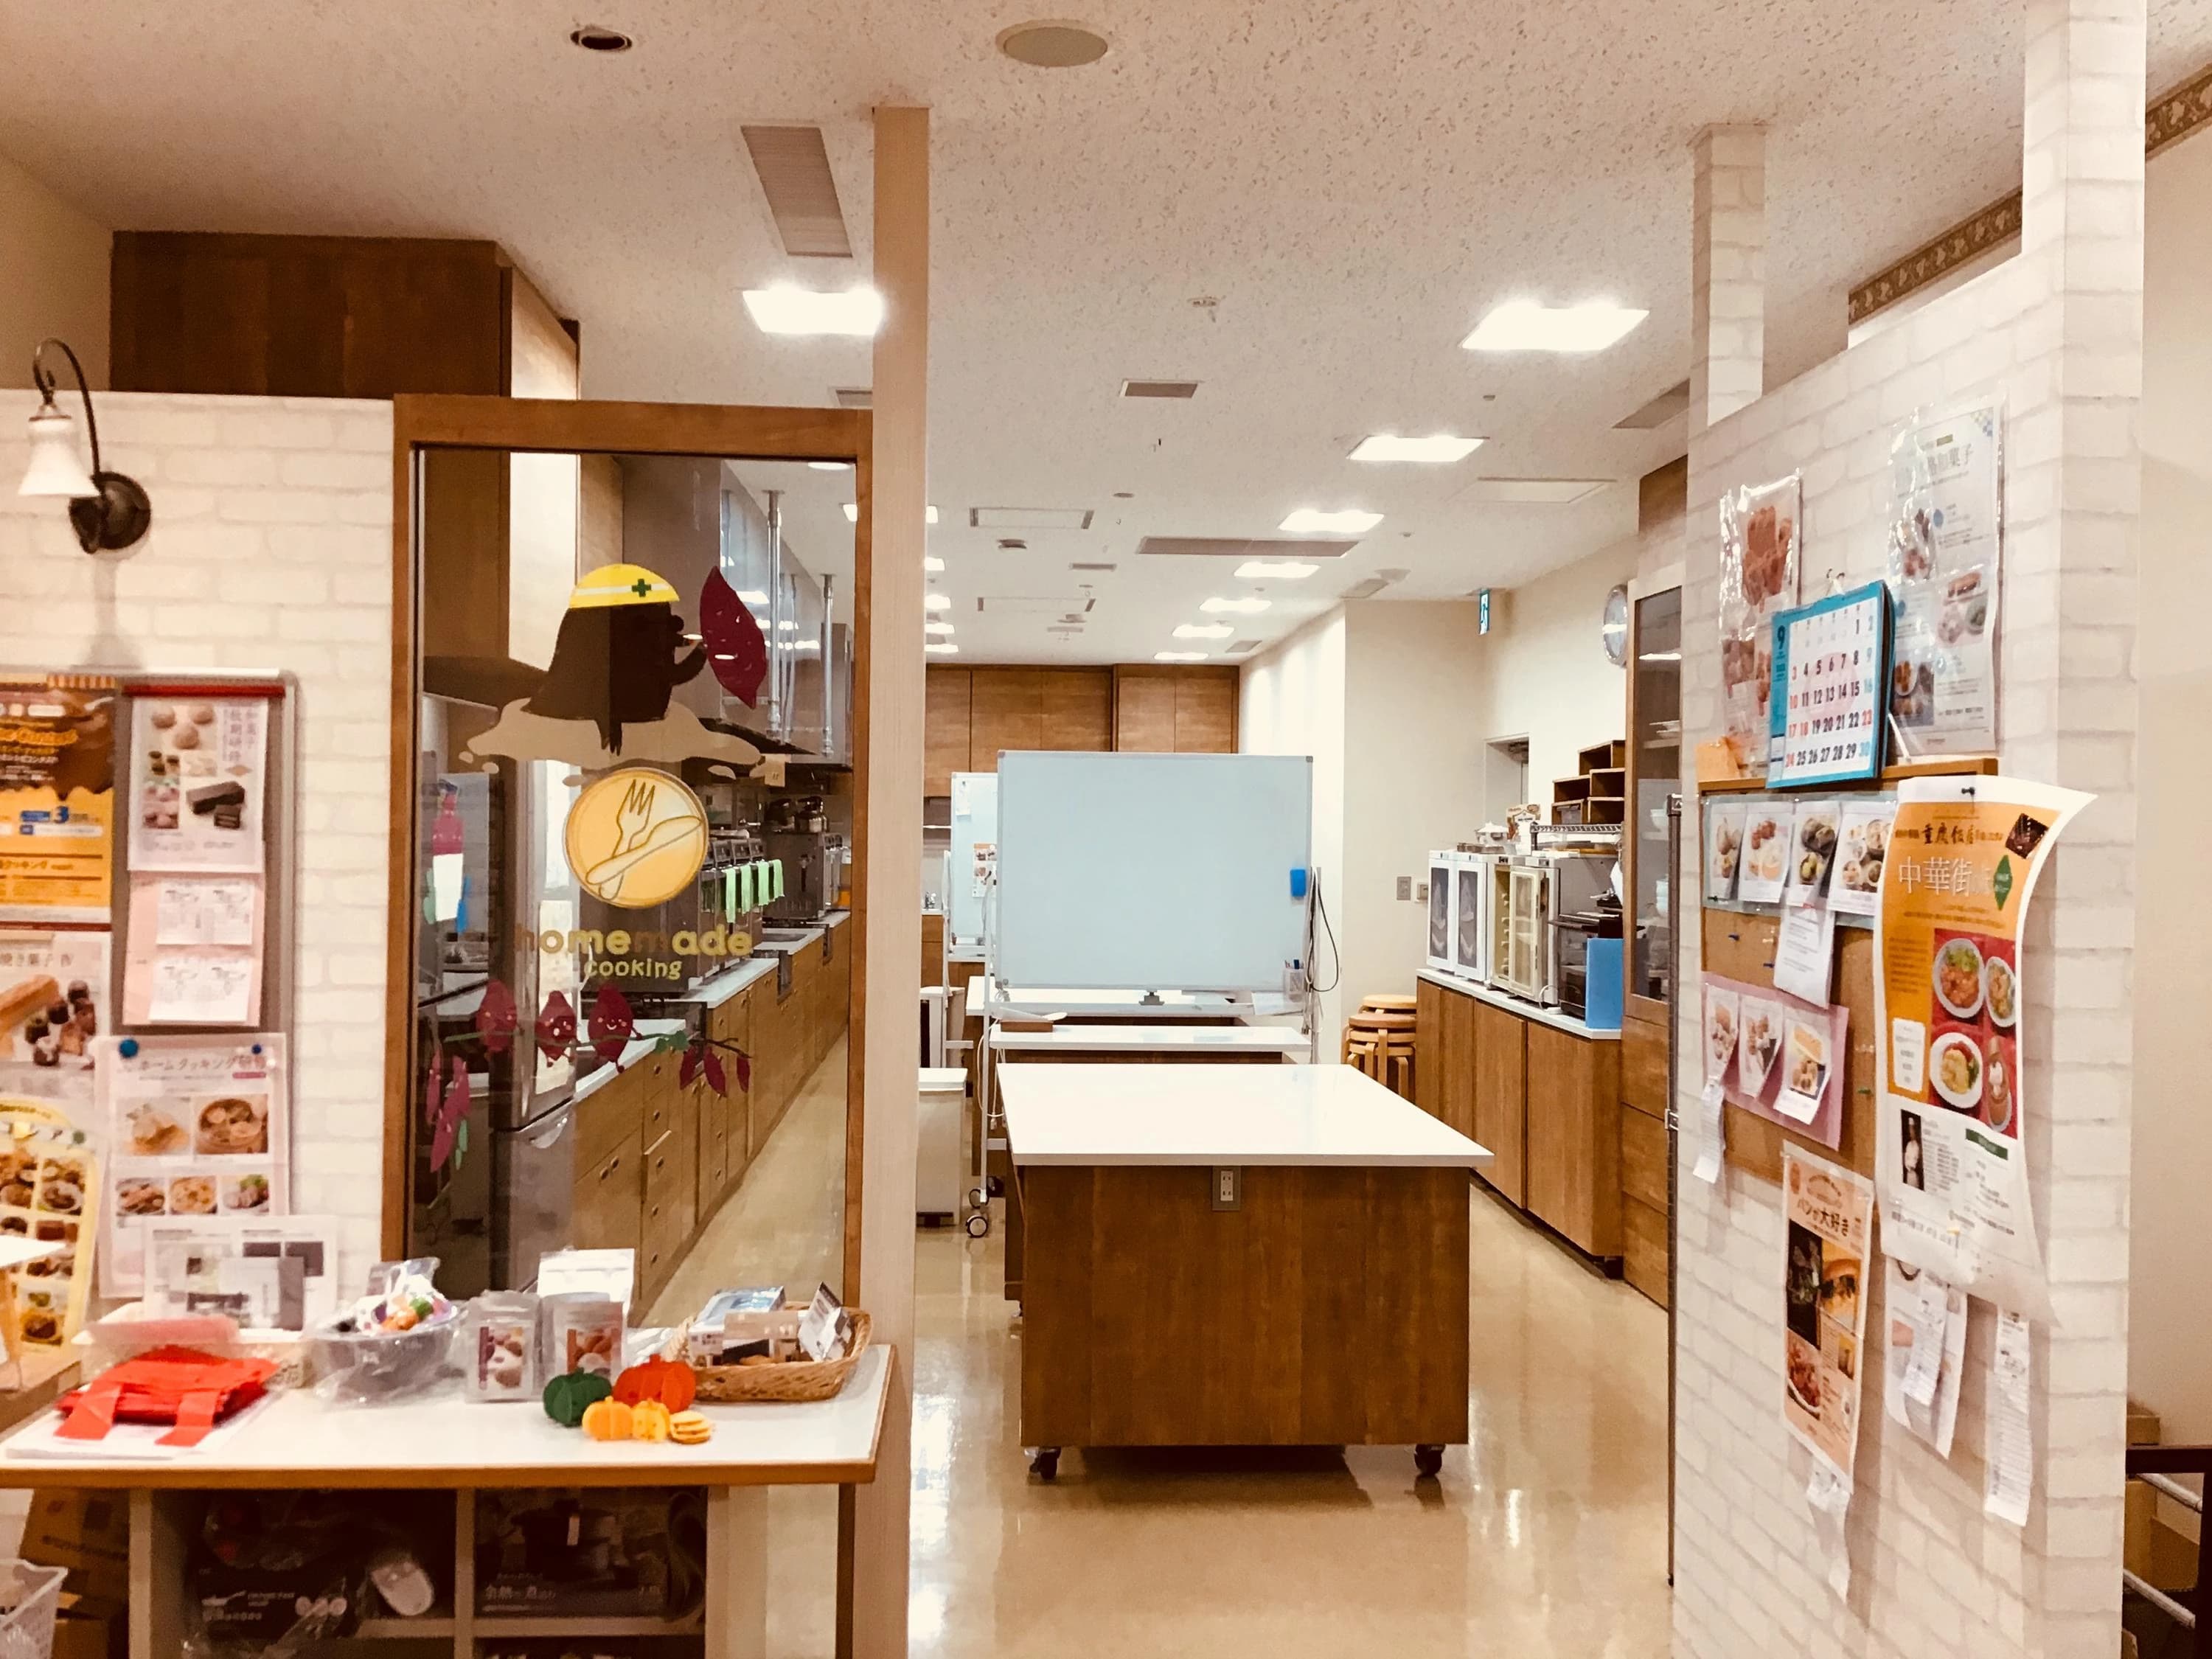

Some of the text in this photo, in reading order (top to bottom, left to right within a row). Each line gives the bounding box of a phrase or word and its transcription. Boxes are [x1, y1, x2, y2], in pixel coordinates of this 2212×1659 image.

[1777, 625, 1786, 650] 9
[1856, 616, 1874, 635] 1 2
[1792, 667, 1797, 681] 3
[1804, 662, 1809, 675] 4
[1816, 660, 1822, 675] 5
[1829, 657, 1834, 672] 6
[1841, 653, 1846, 669] 7
[1854, 650, 1859, 666] 8
[1790, 695, 1798, 709] 10
[1801, 692, 1809, 707] 11
[1814, 689, 1822, 705] 12
[1826, 686, 1834, 703] 13
[1838, 684, 1847, 700] 14
[1851, 681, 1860, 697] 15
[1789, 709, 1872, 738] 17 18 19 20 21 22 23
[1785, 753, 1795, 768] 24
[1797, 750, 1806, 766] 25
[1808, 748, 1818, 765] 26
[1820, 747, 1831, 763] 27
[1832, 745, 1843, 761] 28
[1846, 742, 1857, 759] 29
[54, 806, 69, 824] 3
[515, 923, 753, 956] homemade
[583, 958, 683, 981] cooking
